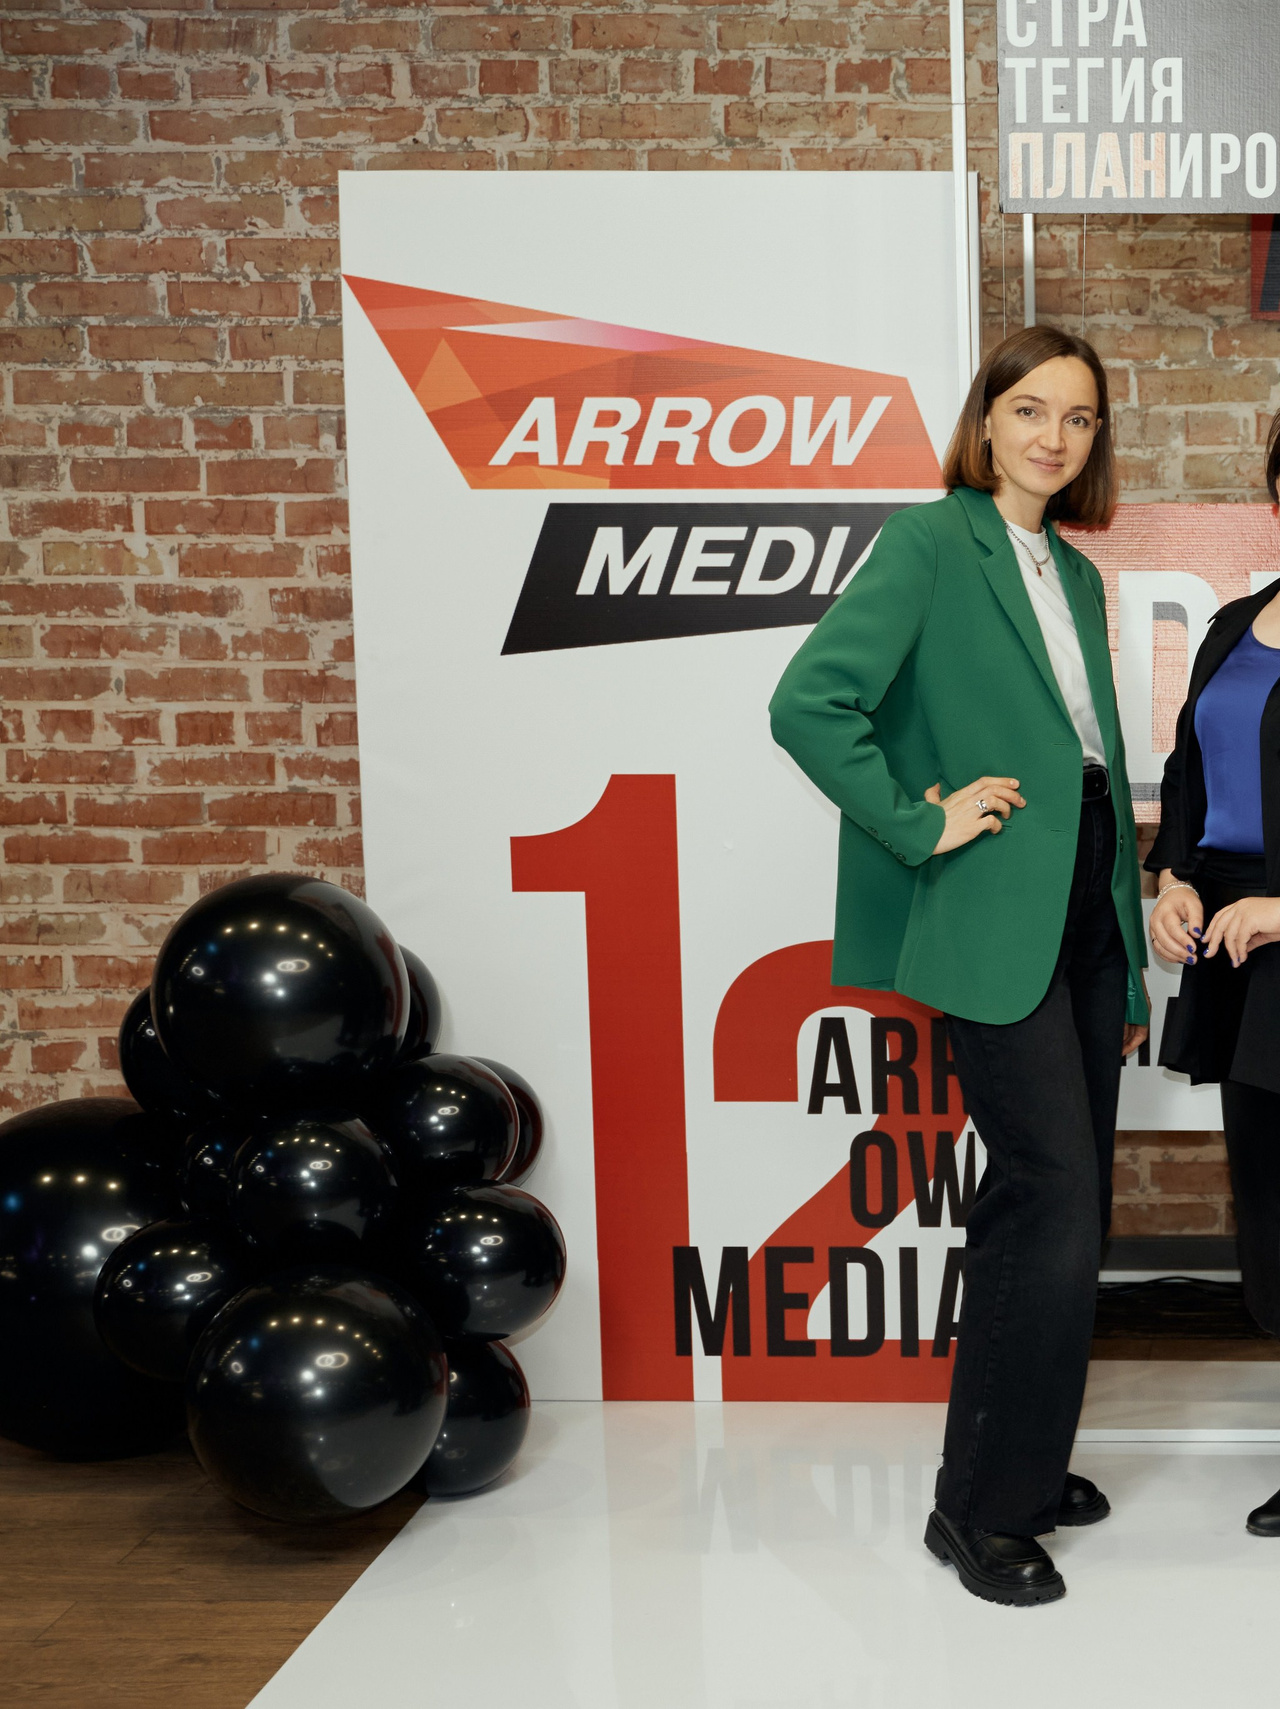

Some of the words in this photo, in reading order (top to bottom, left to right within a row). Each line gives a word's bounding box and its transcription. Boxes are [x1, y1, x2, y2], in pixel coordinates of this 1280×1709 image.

[1005, 57, 1183, 124] ТЕГИЯ
[488, 395, 892, 467] ARROW
[849, 1130, 976, 1228] OW
